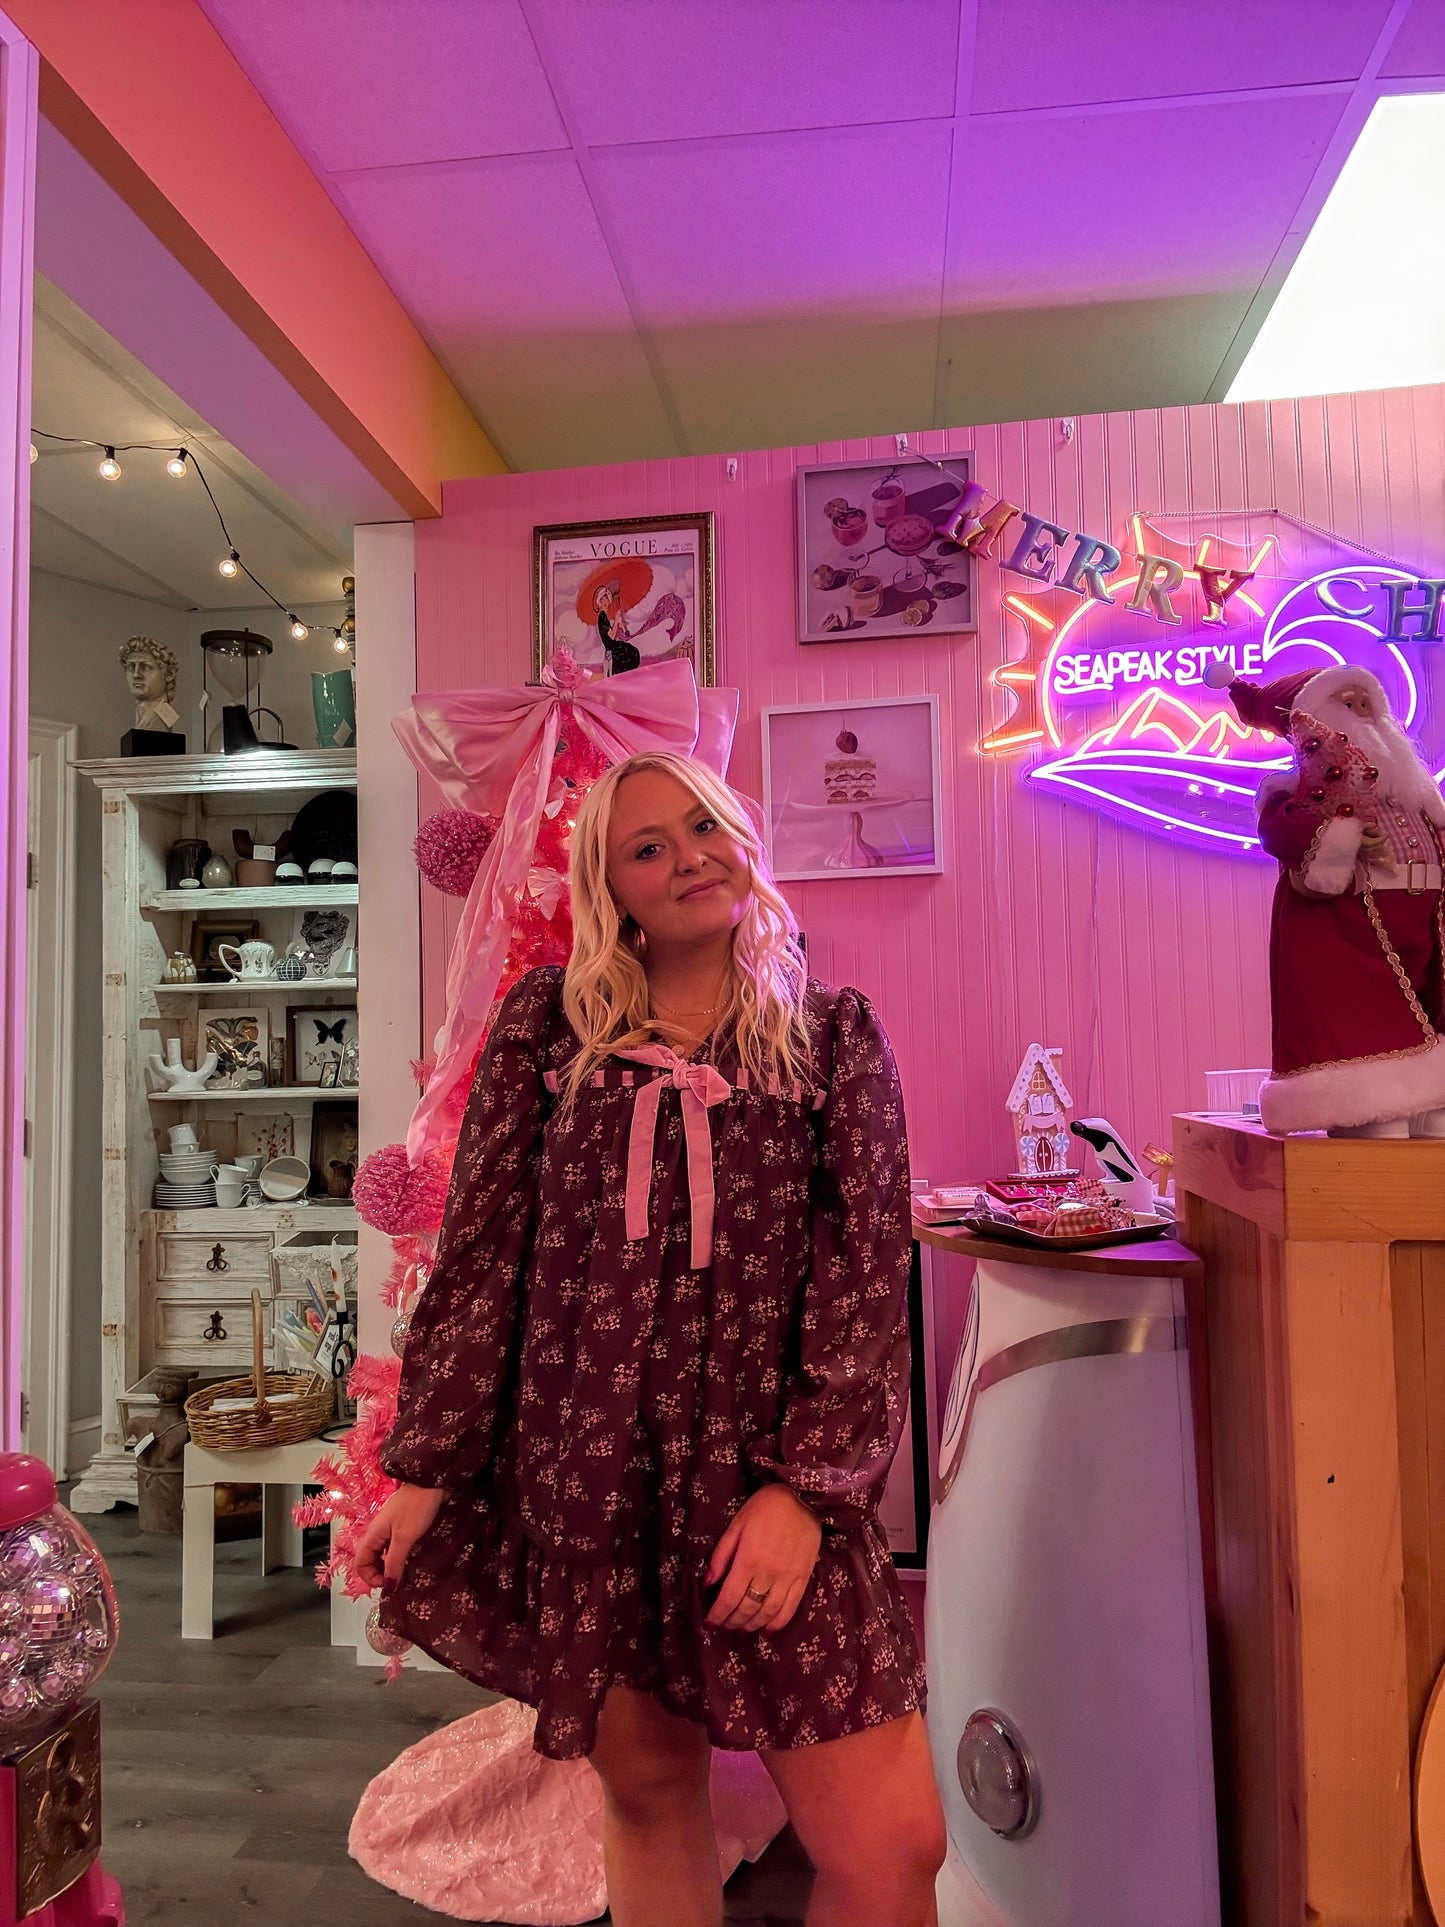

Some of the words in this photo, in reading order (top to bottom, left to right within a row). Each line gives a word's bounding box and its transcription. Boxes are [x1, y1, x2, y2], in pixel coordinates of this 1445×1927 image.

[591, 539, 658, 557] VOGUE
[935, 480, 1255, 627] MERRY
[1054, 649, 1172, 695] SEAPEAK
